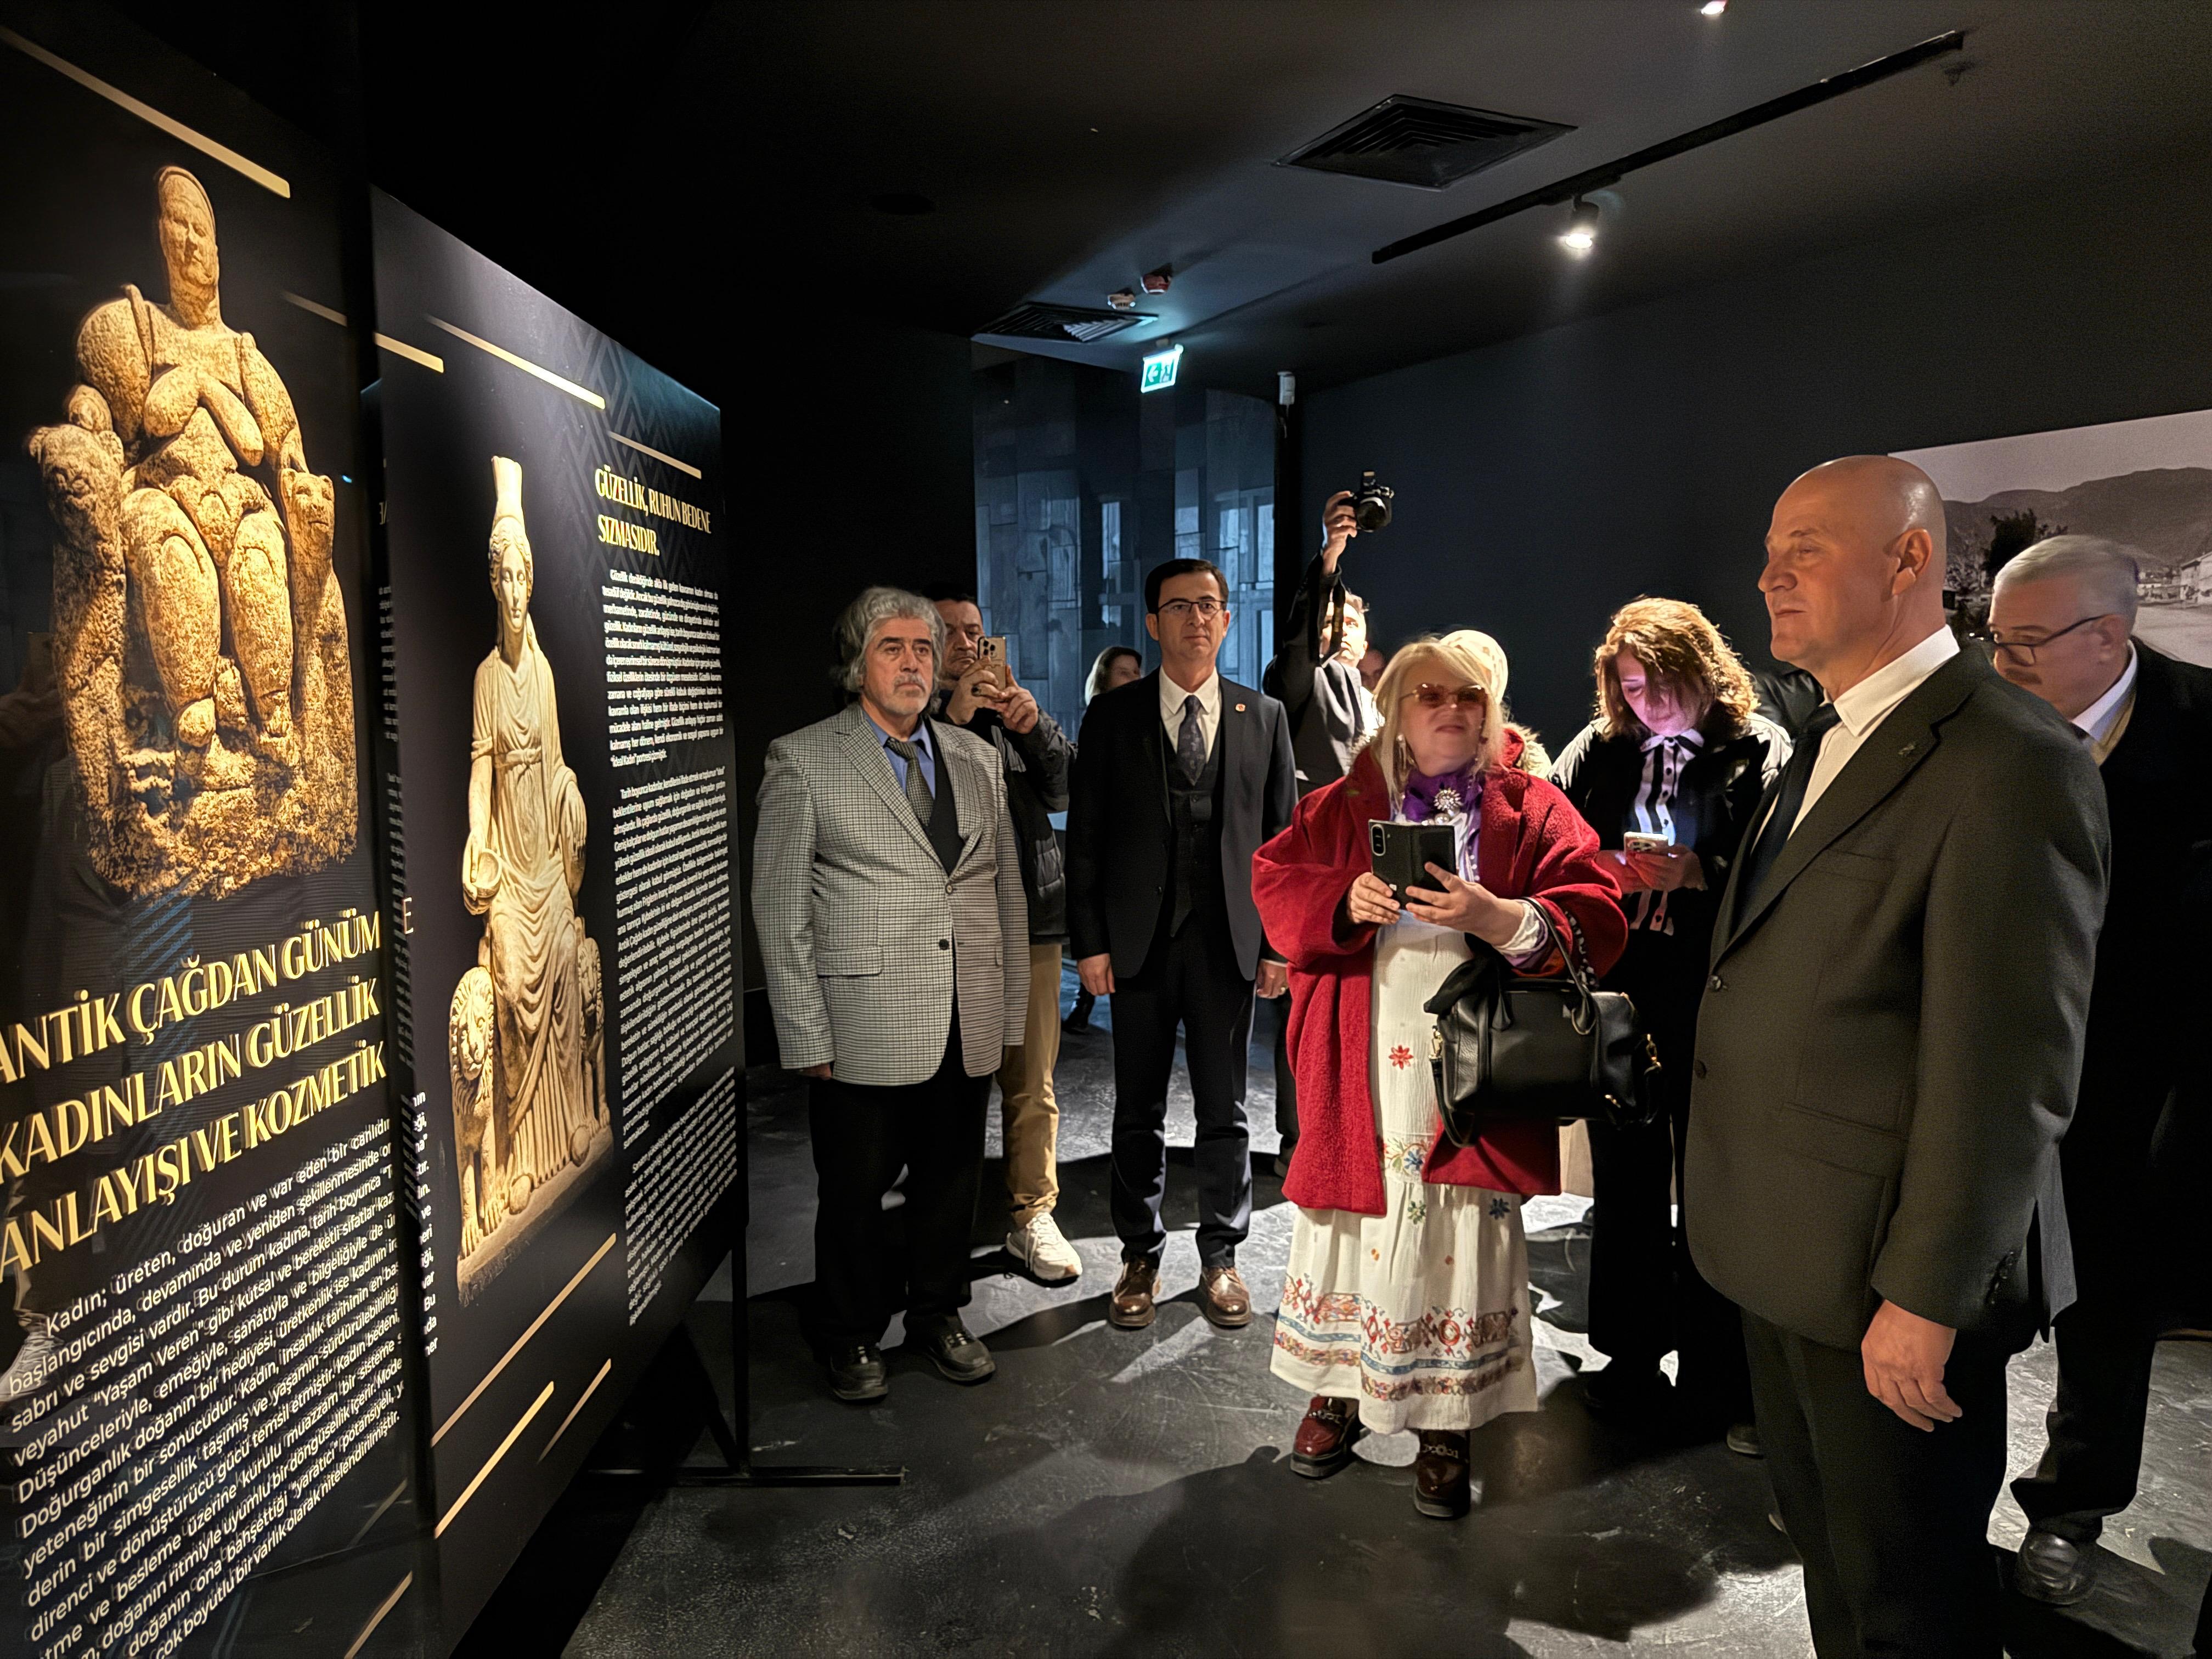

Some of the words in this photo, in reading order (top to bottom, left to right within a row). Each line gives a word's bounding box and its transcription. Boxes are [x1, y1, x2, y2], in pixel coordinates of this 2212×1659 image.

[595, 464, 648, 516] GÜZELLİK,
[648, 488, 681, 523] RUHUN
[681, 501, 712, 534] BEDENE
[598, 514, 660, 556] SIZMASIDIR.
[128, 944, 276, 1045] ÇAĞDAN
[249, 975, 380, 1068] GÜZELLİK
[0, 1137, 191, 1283] ANLAYIŞI
[195, 1112, 242, 1172] VE
[247, 1040, 386, 1149] KOZMETİK
[8, 1308, 136, 1398] başlangıcında,
[143, 1252, 221, 1311] devamında
[227, 1239, 242, 1257] ve
[247, 1206, 295, 1250] yeniden
[299, 1151, 379, 1215] şekillenmesinde
[47, 1289, 106, 1338] Kadın;
[116, 1251, 176, 1294] üreten,
[183, 1207, 245, 1254] doğuran
[251, 1194, 267, 1212] ve
[273, 1177, 293, 1198] var
[298, 1158, 327, 1183] eden
[332, 1143, 347, 1163] bir
[12, 1391, 58, 1432] sabrı
[64, 1374, 84, 1396] ve
[91, 1328, 144, 1380] sevgisi
[150, 1302, 194, 1339] vardır.
[199, 1284, 217, 1308] Bu
[223, 1254, 265, 1290] durum
[269, 1226, 310, 1260] kadına,
[313, 1198, 336, 1229] tarih
[339, 1176, 381, 1211] boyunca
[15, 1404, 89, 1466] veyahut
[209, 1300, 234, 1335] gibi
[238, 1271, 274, 1311] kutsal
[278, 1265, 291, 1282] ve
[295, 1225, 340, 1271] bereketli
[342, 1205, 375, 1235] sıfatlar
[20, 1398, 152, 1503] Düşünceleriyle,
[160, 1342, 228, 1398] emeğiyle,
[234, 1295, 288, 1344] sanatıyla
[294, 1282, 307, 1298] ve
[312, 1237, 367, 1286] bilgeliğiyle
[371, 1224, 383, 1240] de
[22, 1443, 131, 1538] Doğurganlık
[136, 1395, 195, 1449] doğanın
[200, 1370, 218, 1400] bir
[223, 1330, 276, 1383] hediyesi,
[280, 1285, 333, 1338] üretkenlik
[335, 1276, 349, 1295] ise
[352, 1248, 386, 1282] kadının
[24, 1481, 128, 1579] yeteneğinin
[134, 1458, 154, 1485] bir
[160, 1386, 237, 1464] sonucudur.
[240, 1362, 279, 1399] Kadın,
[283, 1317, 324, 1365] insanlık
[326, 1288, 368, 1328] tarihinin
[371, 1276, 382, 1292] en
[29, 1559, 76, 1606] derin
[84, 1531, 106, 1561] bir
[114, 1455, 198, 1536] simgesellik
[202, 1413, 249, 1460] taşımış
[253, 1398, 268, 1417] ve
[272, 1355, 318, 1406] yaşamın
[32, 1573, 92, 1641] direnci
[97, 1559, 116, 1583] ve
[121, 1470, 214, 1563] dönüştürücü
[217, 1436, 249, 1483] gücü
[252, 1403, 289, 1447] temsil
[291, 1363, 335, 1413] etmiştir.
[337, 1342, 365, 1374] Kadın
[90, 1600, 109, 1624] ve
[117, 1535, 181, 1601] besleme
[188, 1485, 236, 1536] üzerine
[242, 1443, 281, 1487] kurulu
[286, 1392, 338, 1447] muazzam
[342, 1375, 356, 1396] bir
[359, 1341, 394, 1379] sisteme
[103, 1580, 166, 1649] doğanın
[170, 1528, 222, 1587] ritmiyle
[224, 1476, 270, 1534] uyumlu
[272, 1463, 288, 1489] bir
[290, 1401, 350, 1471] döngüsellik
[351, 1377, 376, 1414] içerir.
[129, 1590, 190, 1657] doğanın
[197, 1560, 222, 1591] ona
[227, 1491, 287, 1562] bahşettiği
[342, 1389, 394, 1452] potansiyeli,
[184, 1573, 234, 1637] boyutlu
[236, 1556, 252, 1583] bir
[255, 1521, 286, 1564] varlık
[286, 1487, 320, 1531] olarak
[321, 1411, 399, 1497] nitelendirilmiştir.
